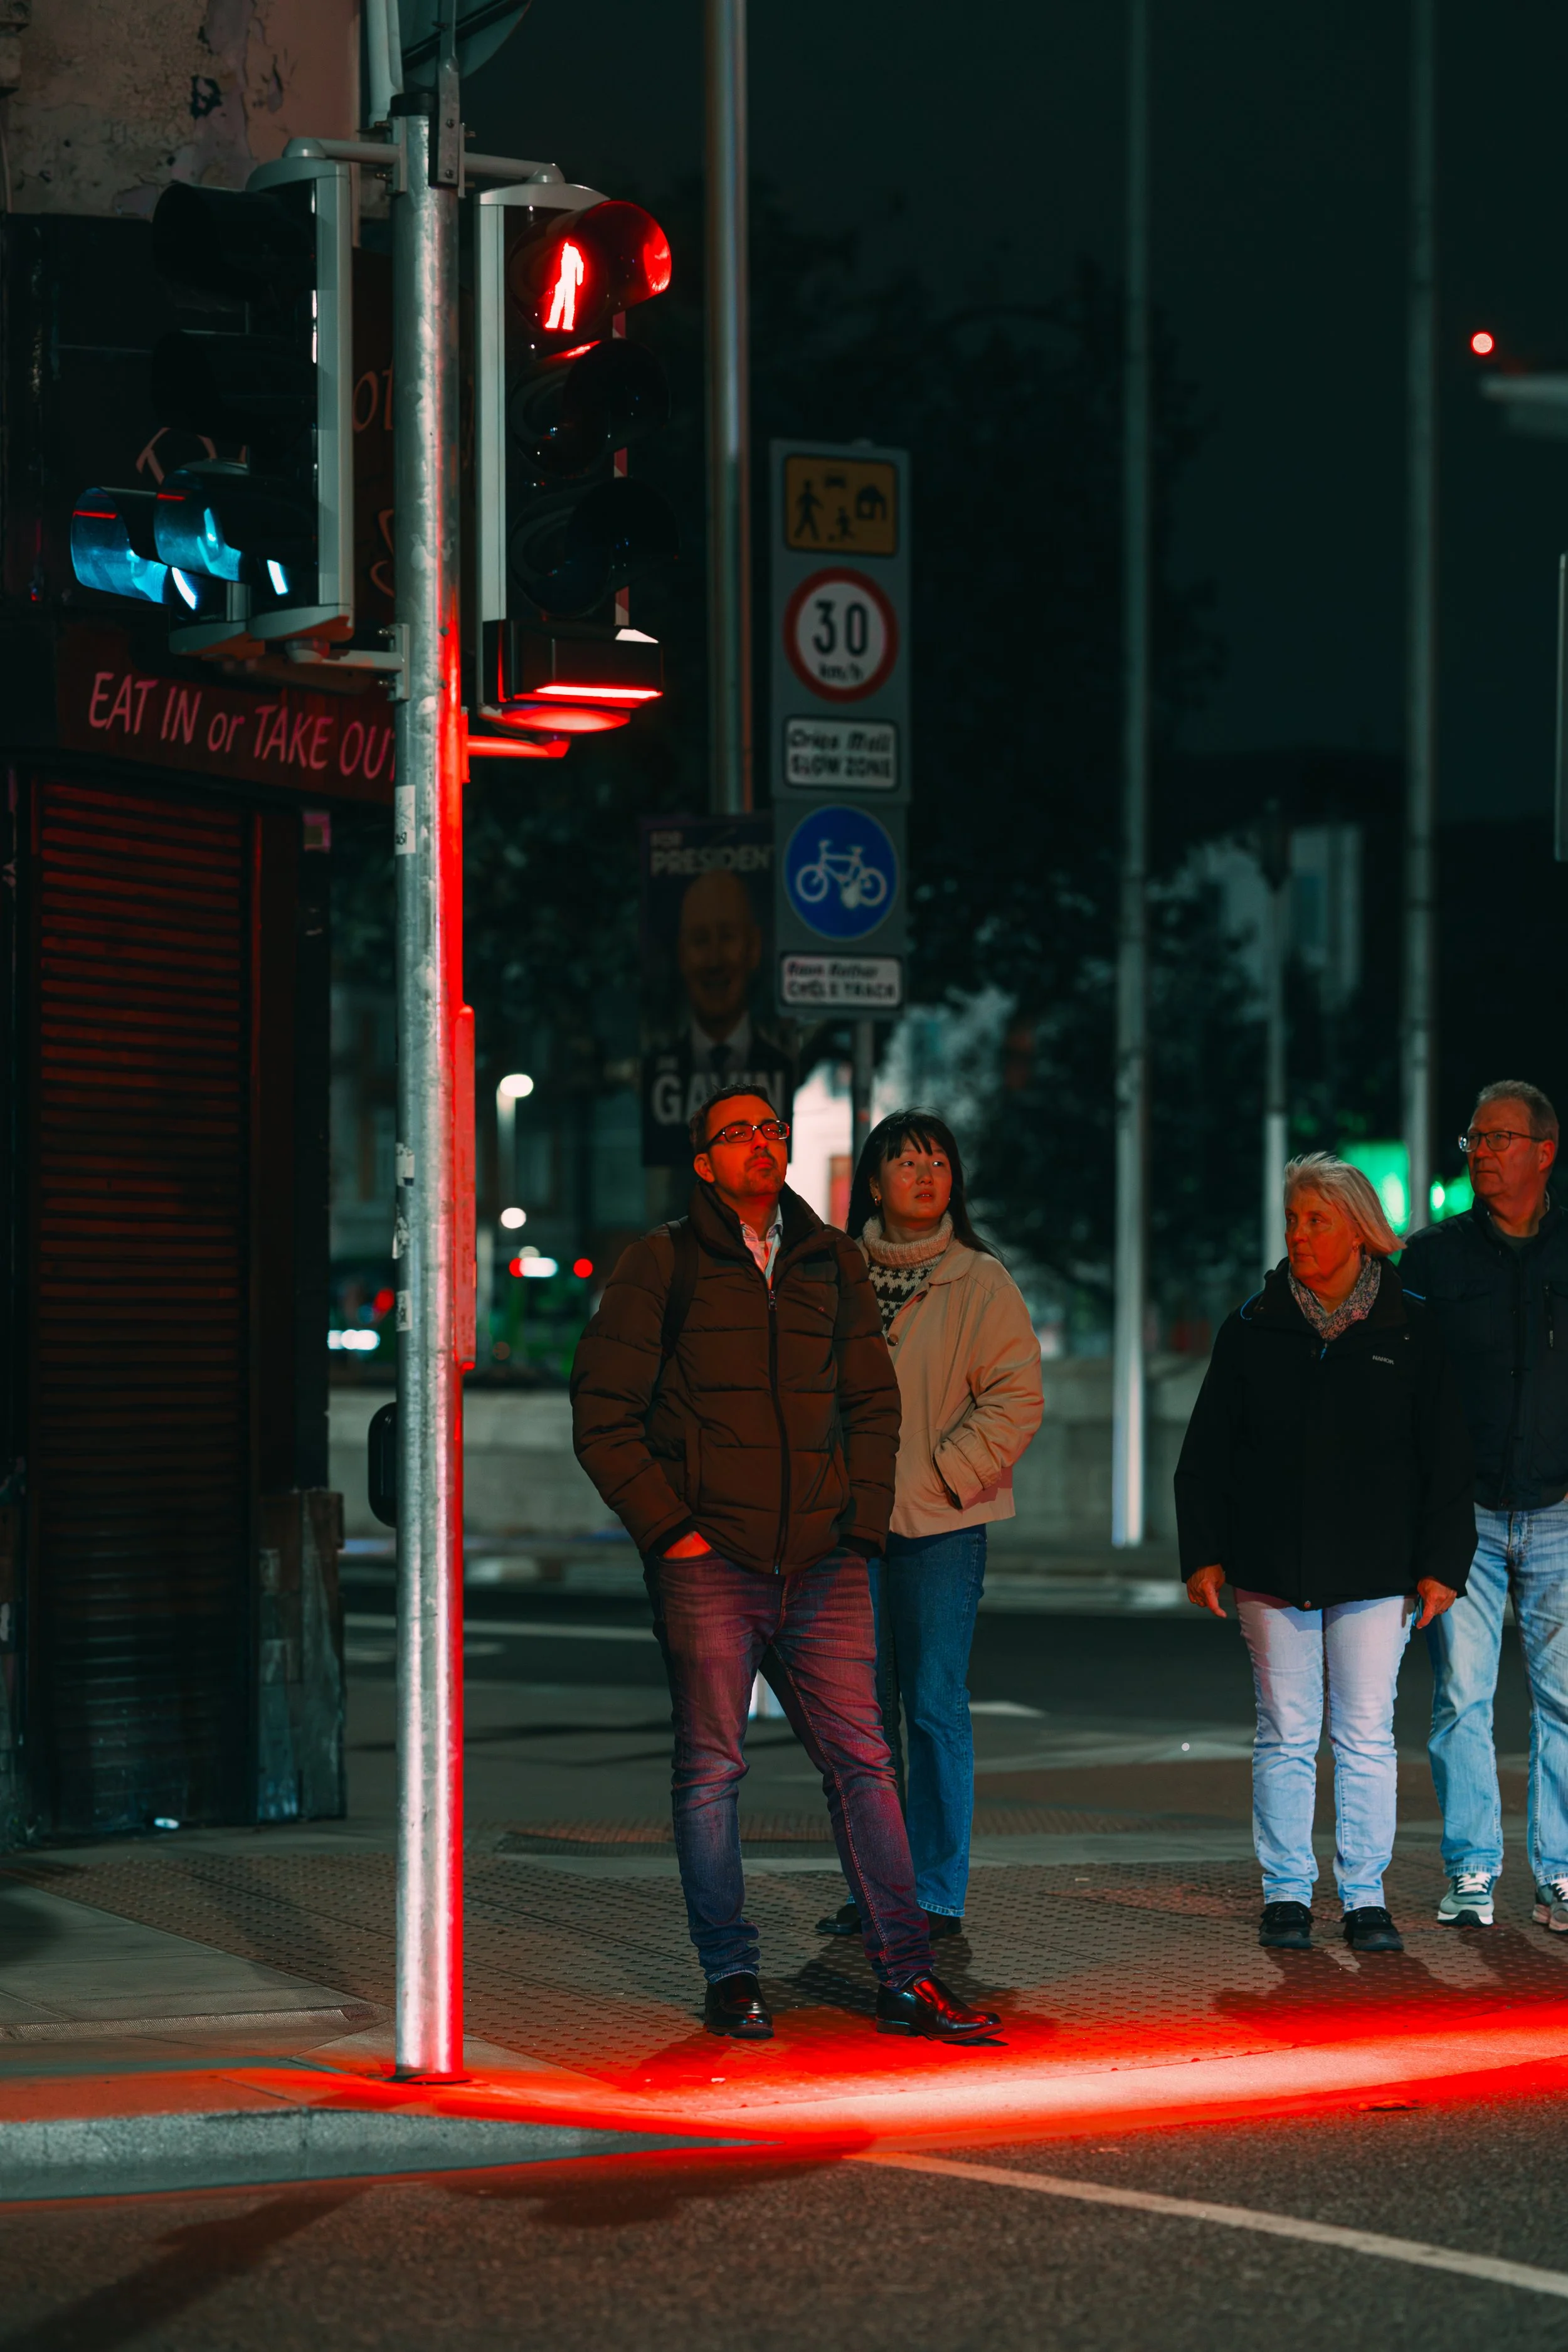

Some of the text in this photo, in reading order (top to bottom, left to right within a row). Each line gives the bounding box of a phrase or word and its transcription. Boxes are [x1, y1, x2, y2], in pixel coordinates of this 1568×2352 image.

[814, 601, 867, 655] 30
[89, 672, 158, 734] EAT
[161, 686, 202, 744] IN
[208, 712, 245, 753] or
[253, 705, 333, 770] TAKE
[650, 844, 775, 876] PRESIDEN
